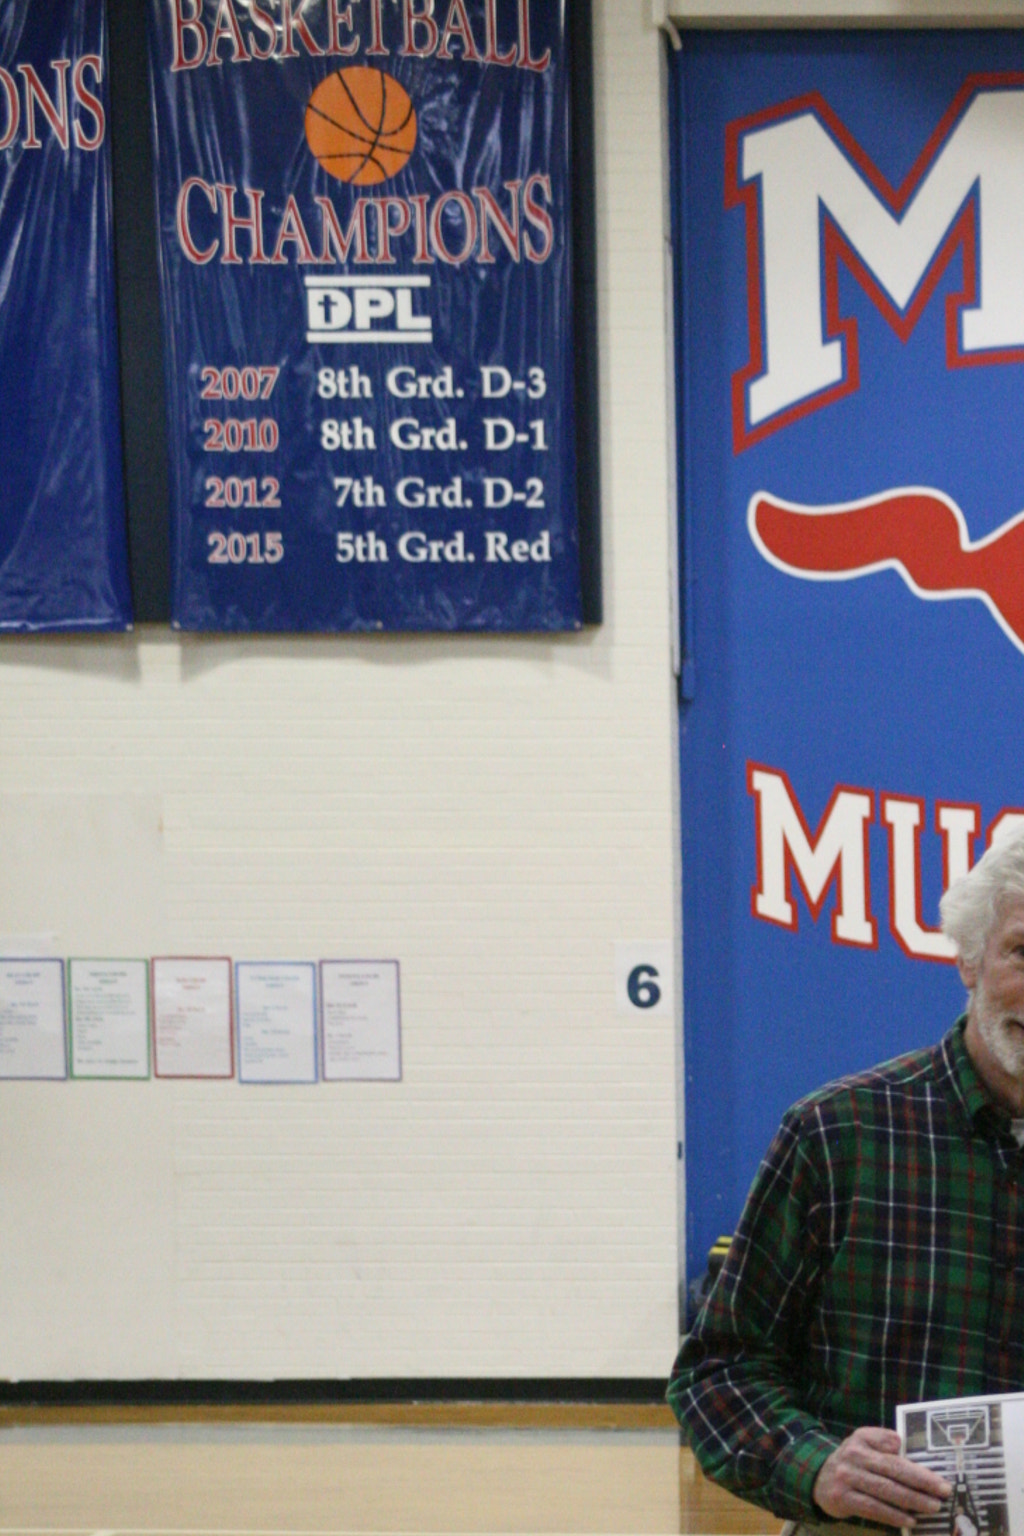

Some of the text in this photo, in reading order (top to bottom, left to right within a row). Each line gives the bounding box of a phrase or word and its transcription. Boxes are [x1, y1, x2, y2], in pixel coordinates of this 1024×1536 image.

[170, 0, 551, 72] BASKETBALL
[176, 173, 554, 265] CHAMPIONS
[307, 287, 432, 330] DPL
[200, 365, 547, 401] 2007 8th Grd. D-3
[203, 417, 549, 452] 2010 8th Grd. D-1
[204, 476, 545, 508] 2012 7th Grd. D-2
[207, 530, 552, 564] 2015 5th Grd. Red
[625, 963, 662, 1009] 6
